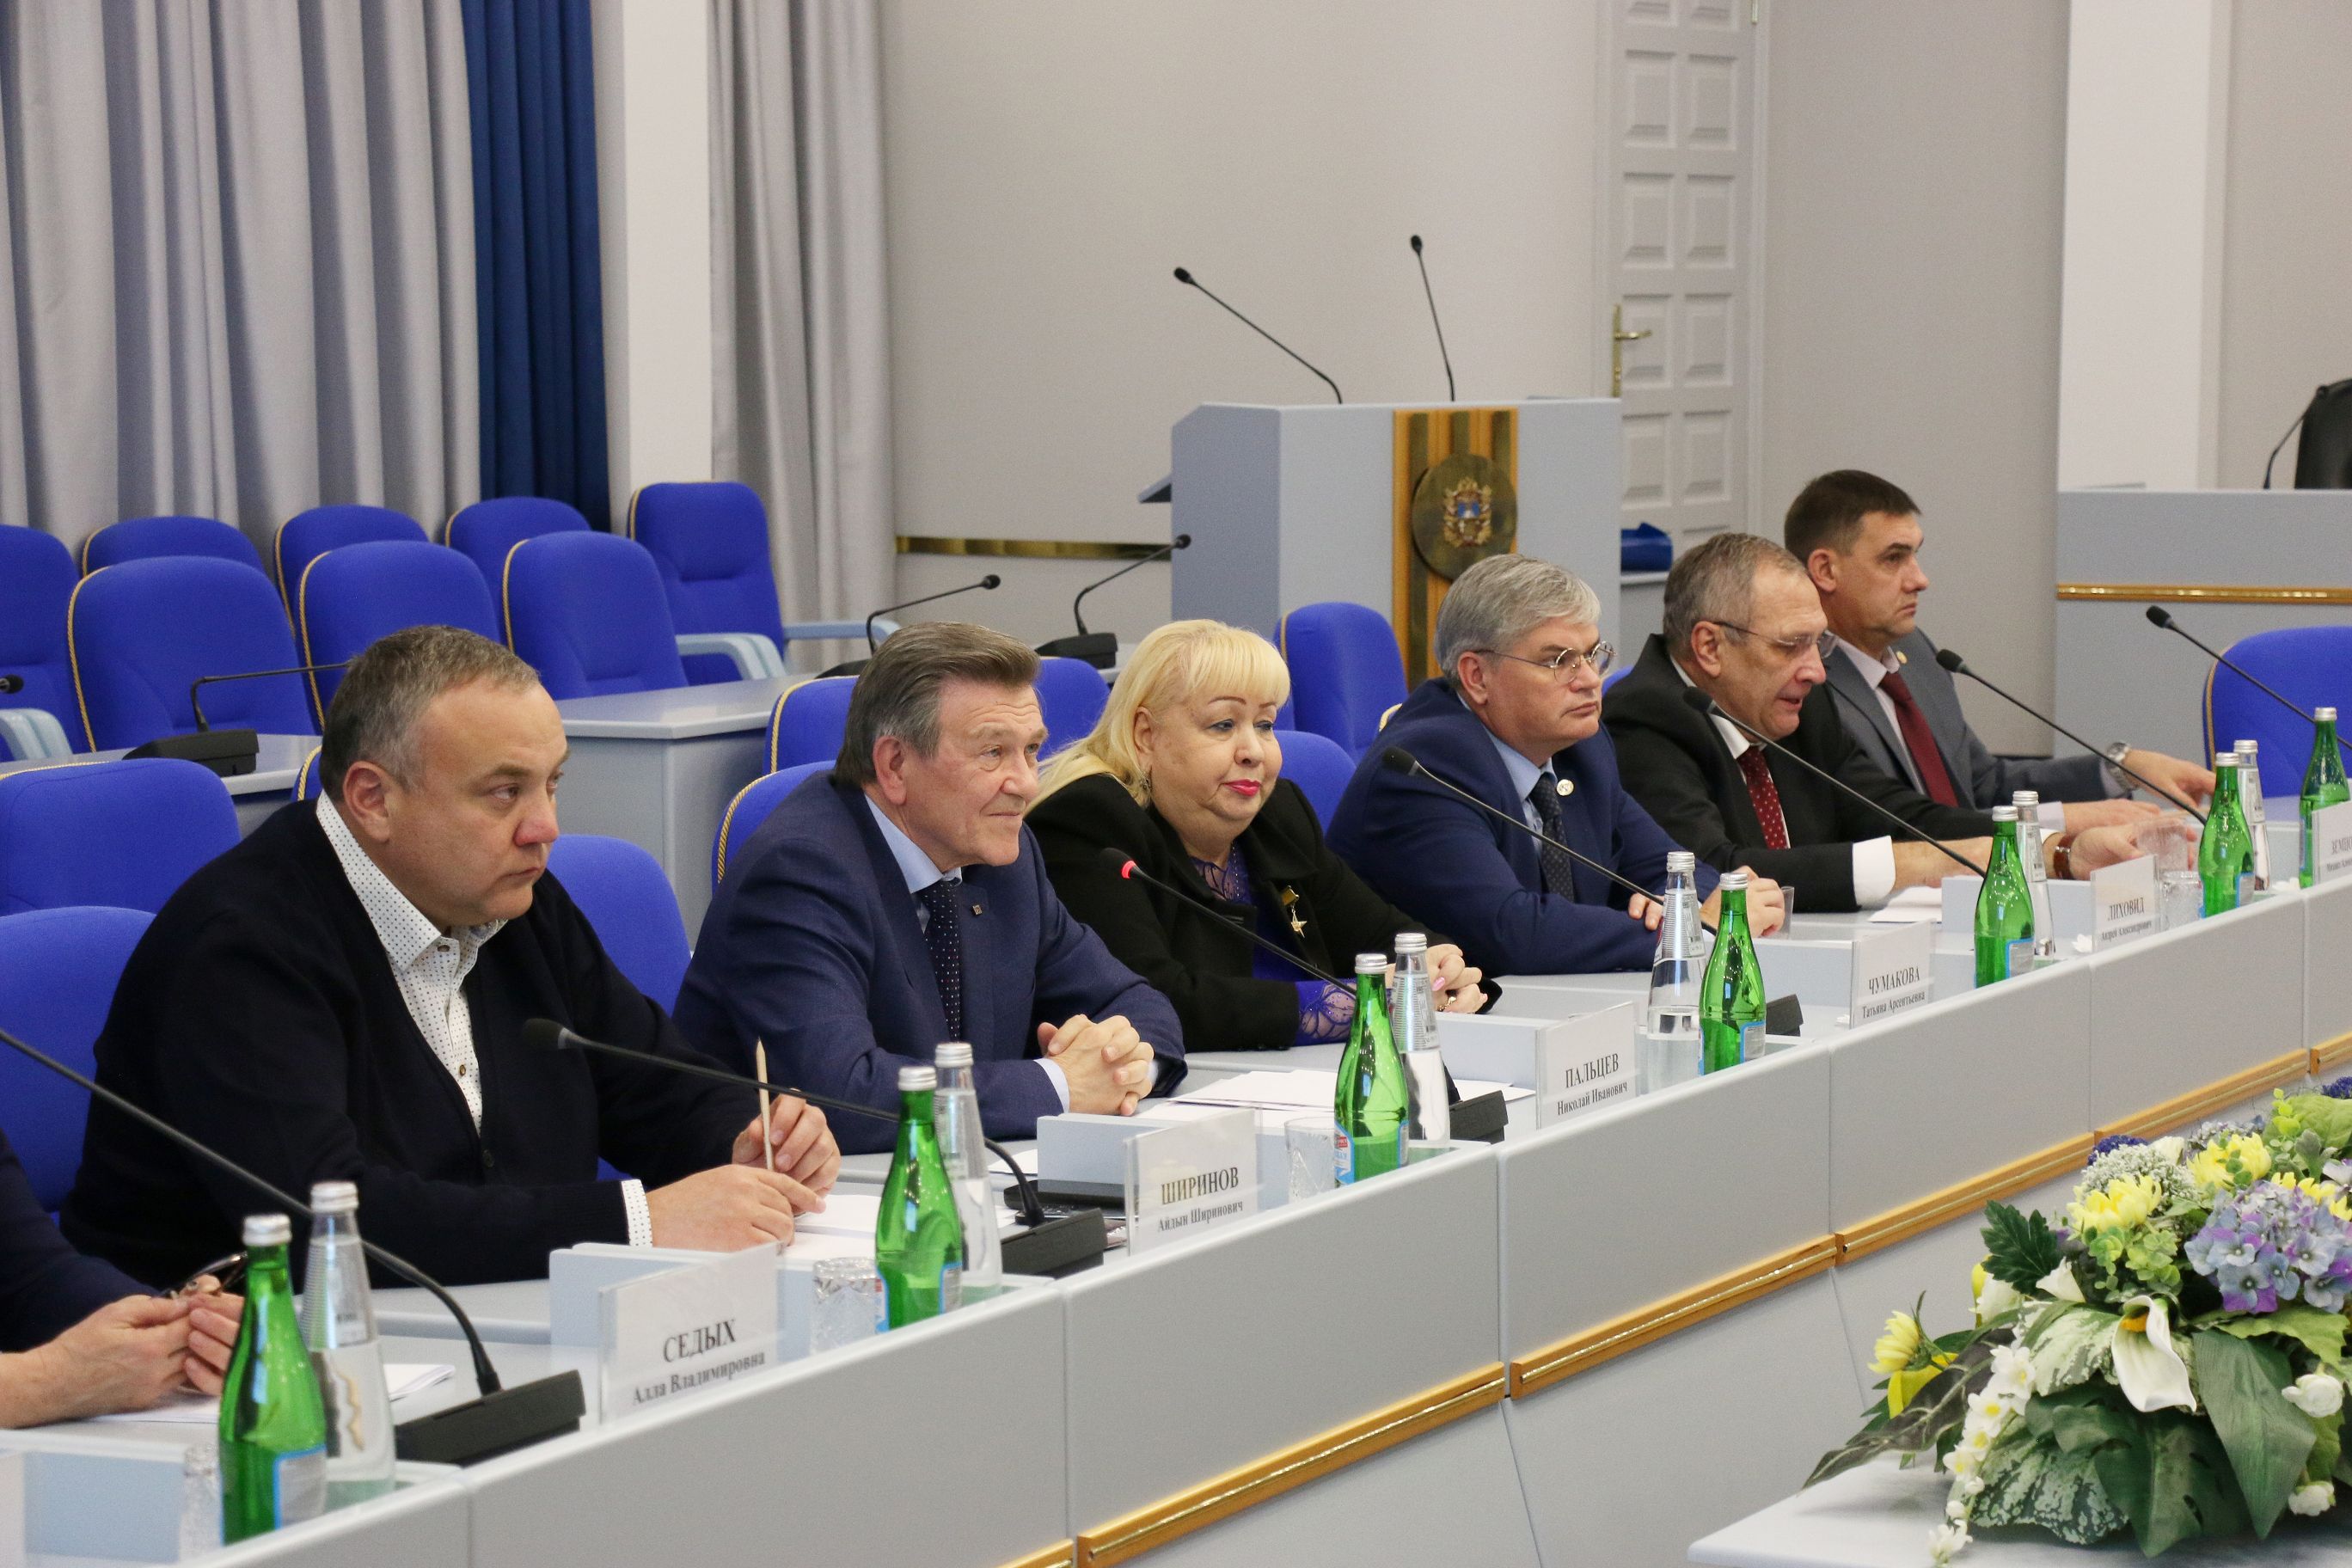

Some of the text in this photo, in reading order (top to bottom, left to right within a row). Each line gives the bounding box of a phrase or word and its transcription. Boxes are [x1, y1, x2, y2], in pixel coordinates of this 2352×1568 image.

[2107, 897, 2145, 922] ЛИХОВИД
[1869, 966, 1920, 995] ЧУМАКОВА
[1862, 991, 1926, 1019] Татьяна Арсентьевна
[1565, 1053, 1619, 1088] ПАЛЬЦЕВ
[1557, 1081, 1627, 1116] Николай Иванович
[1161, 1167, 1239, 1205] ШИРИНОВ
[1158, 1201, 1243, 1232] Айдын Ширинович
[663, 1320, 736, 1363] СЕДЫХ
[633, 1352, 765, 1405] Алла Владимировна
